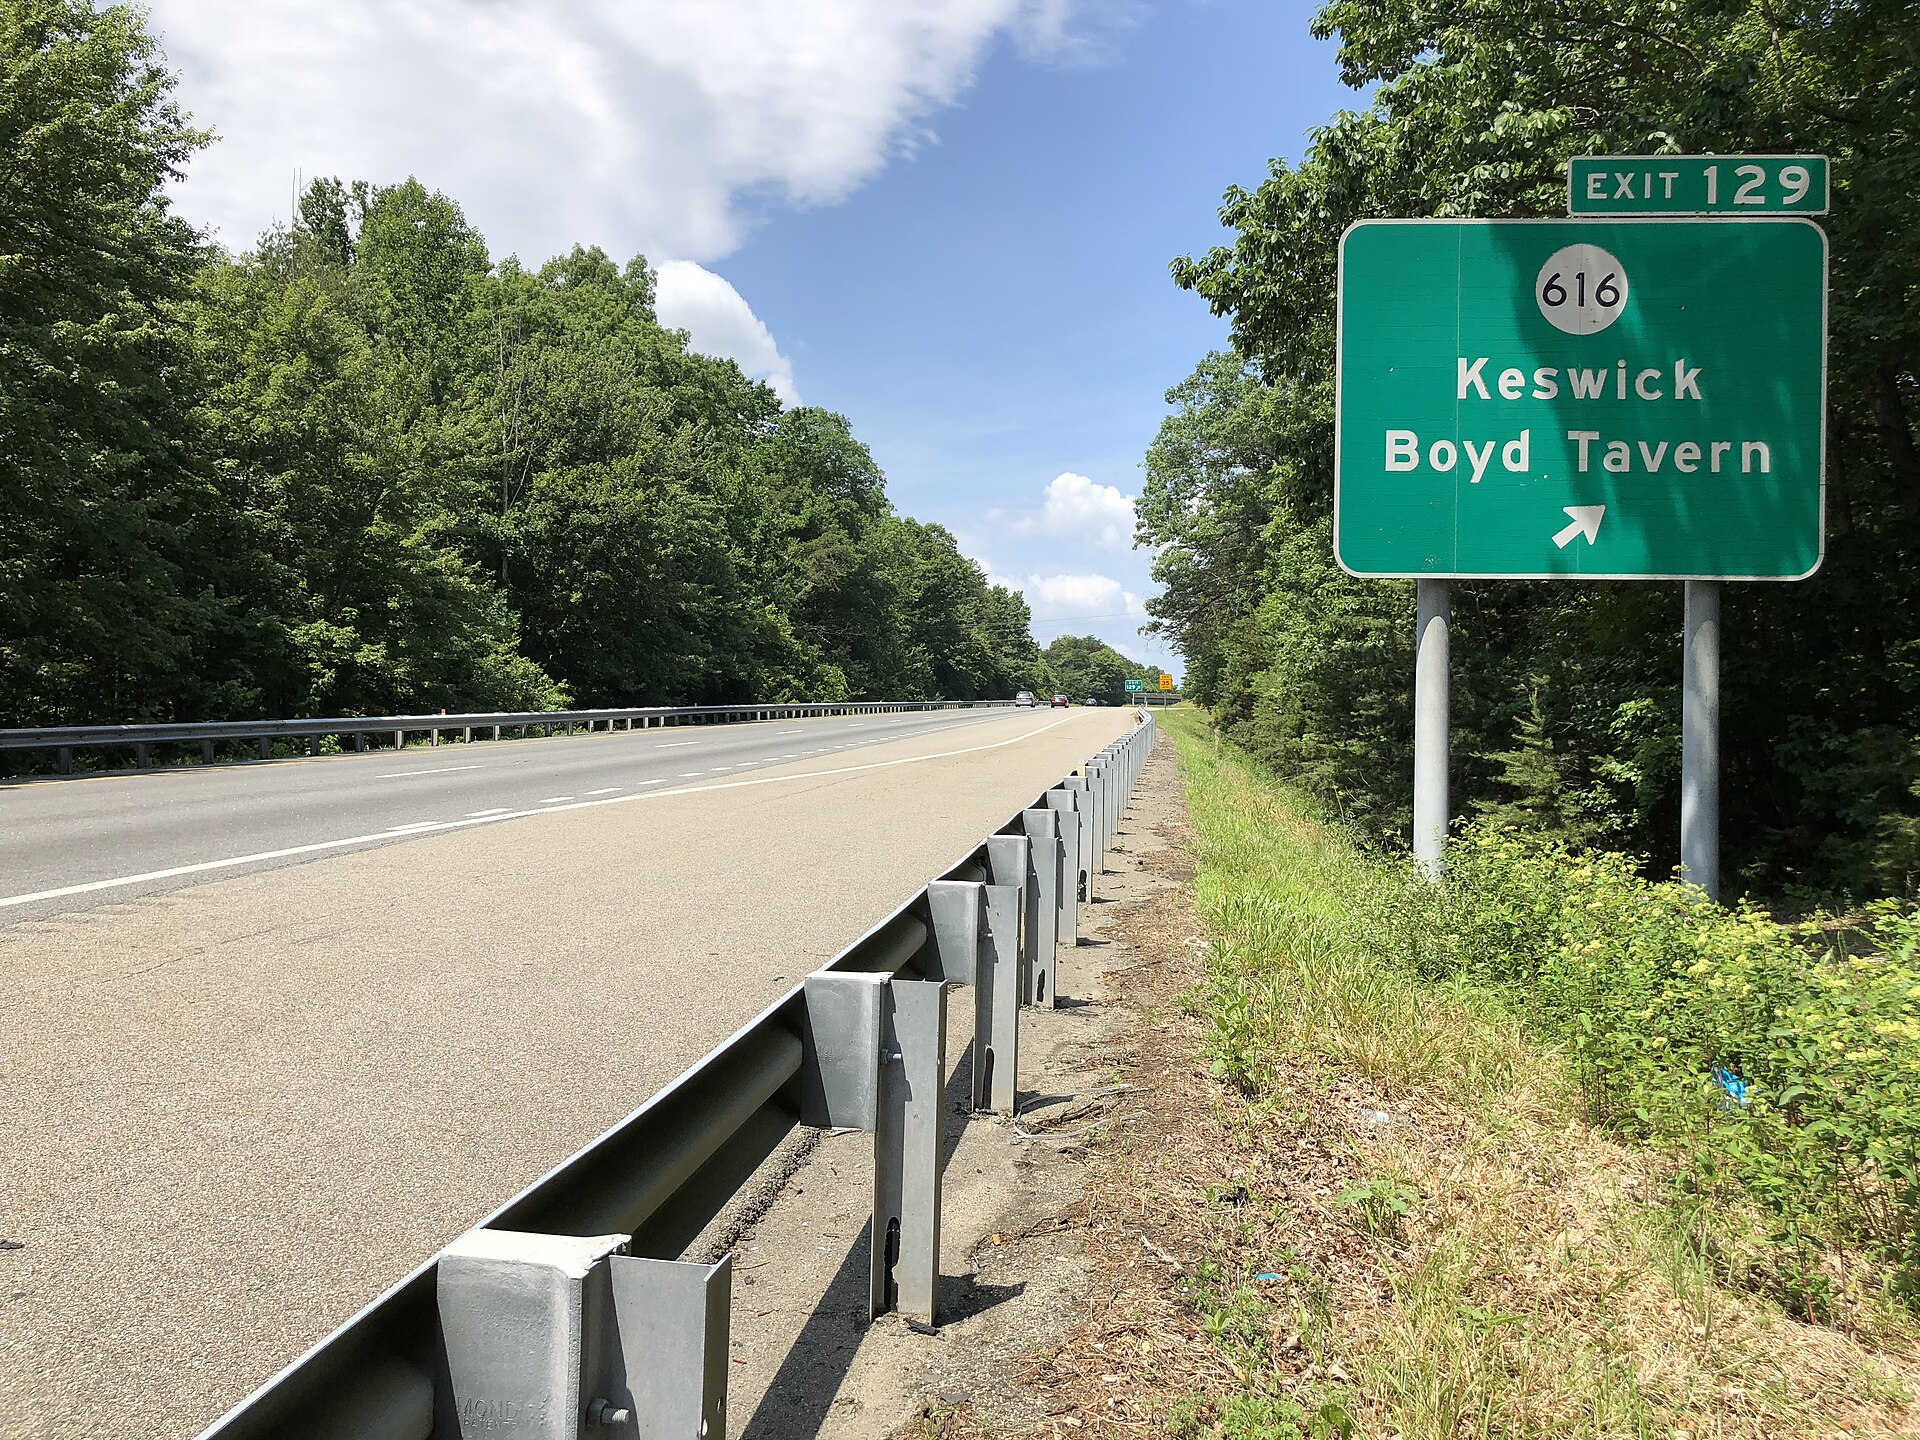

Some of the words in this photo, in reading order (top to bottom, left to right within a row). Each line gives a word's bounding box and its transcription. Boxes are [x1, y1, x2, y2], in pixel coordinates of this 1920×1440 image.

[1586, 171, 1680, 200] EXIT
[1702, 164, 1811, 205] 129
[1541, 272, 1621, 308] 616
[1456, 357, 1703, 401] Keswick
[1385, 428, 1530, 484] Boyd
[1567, 430, 1771, 474] Tavern
